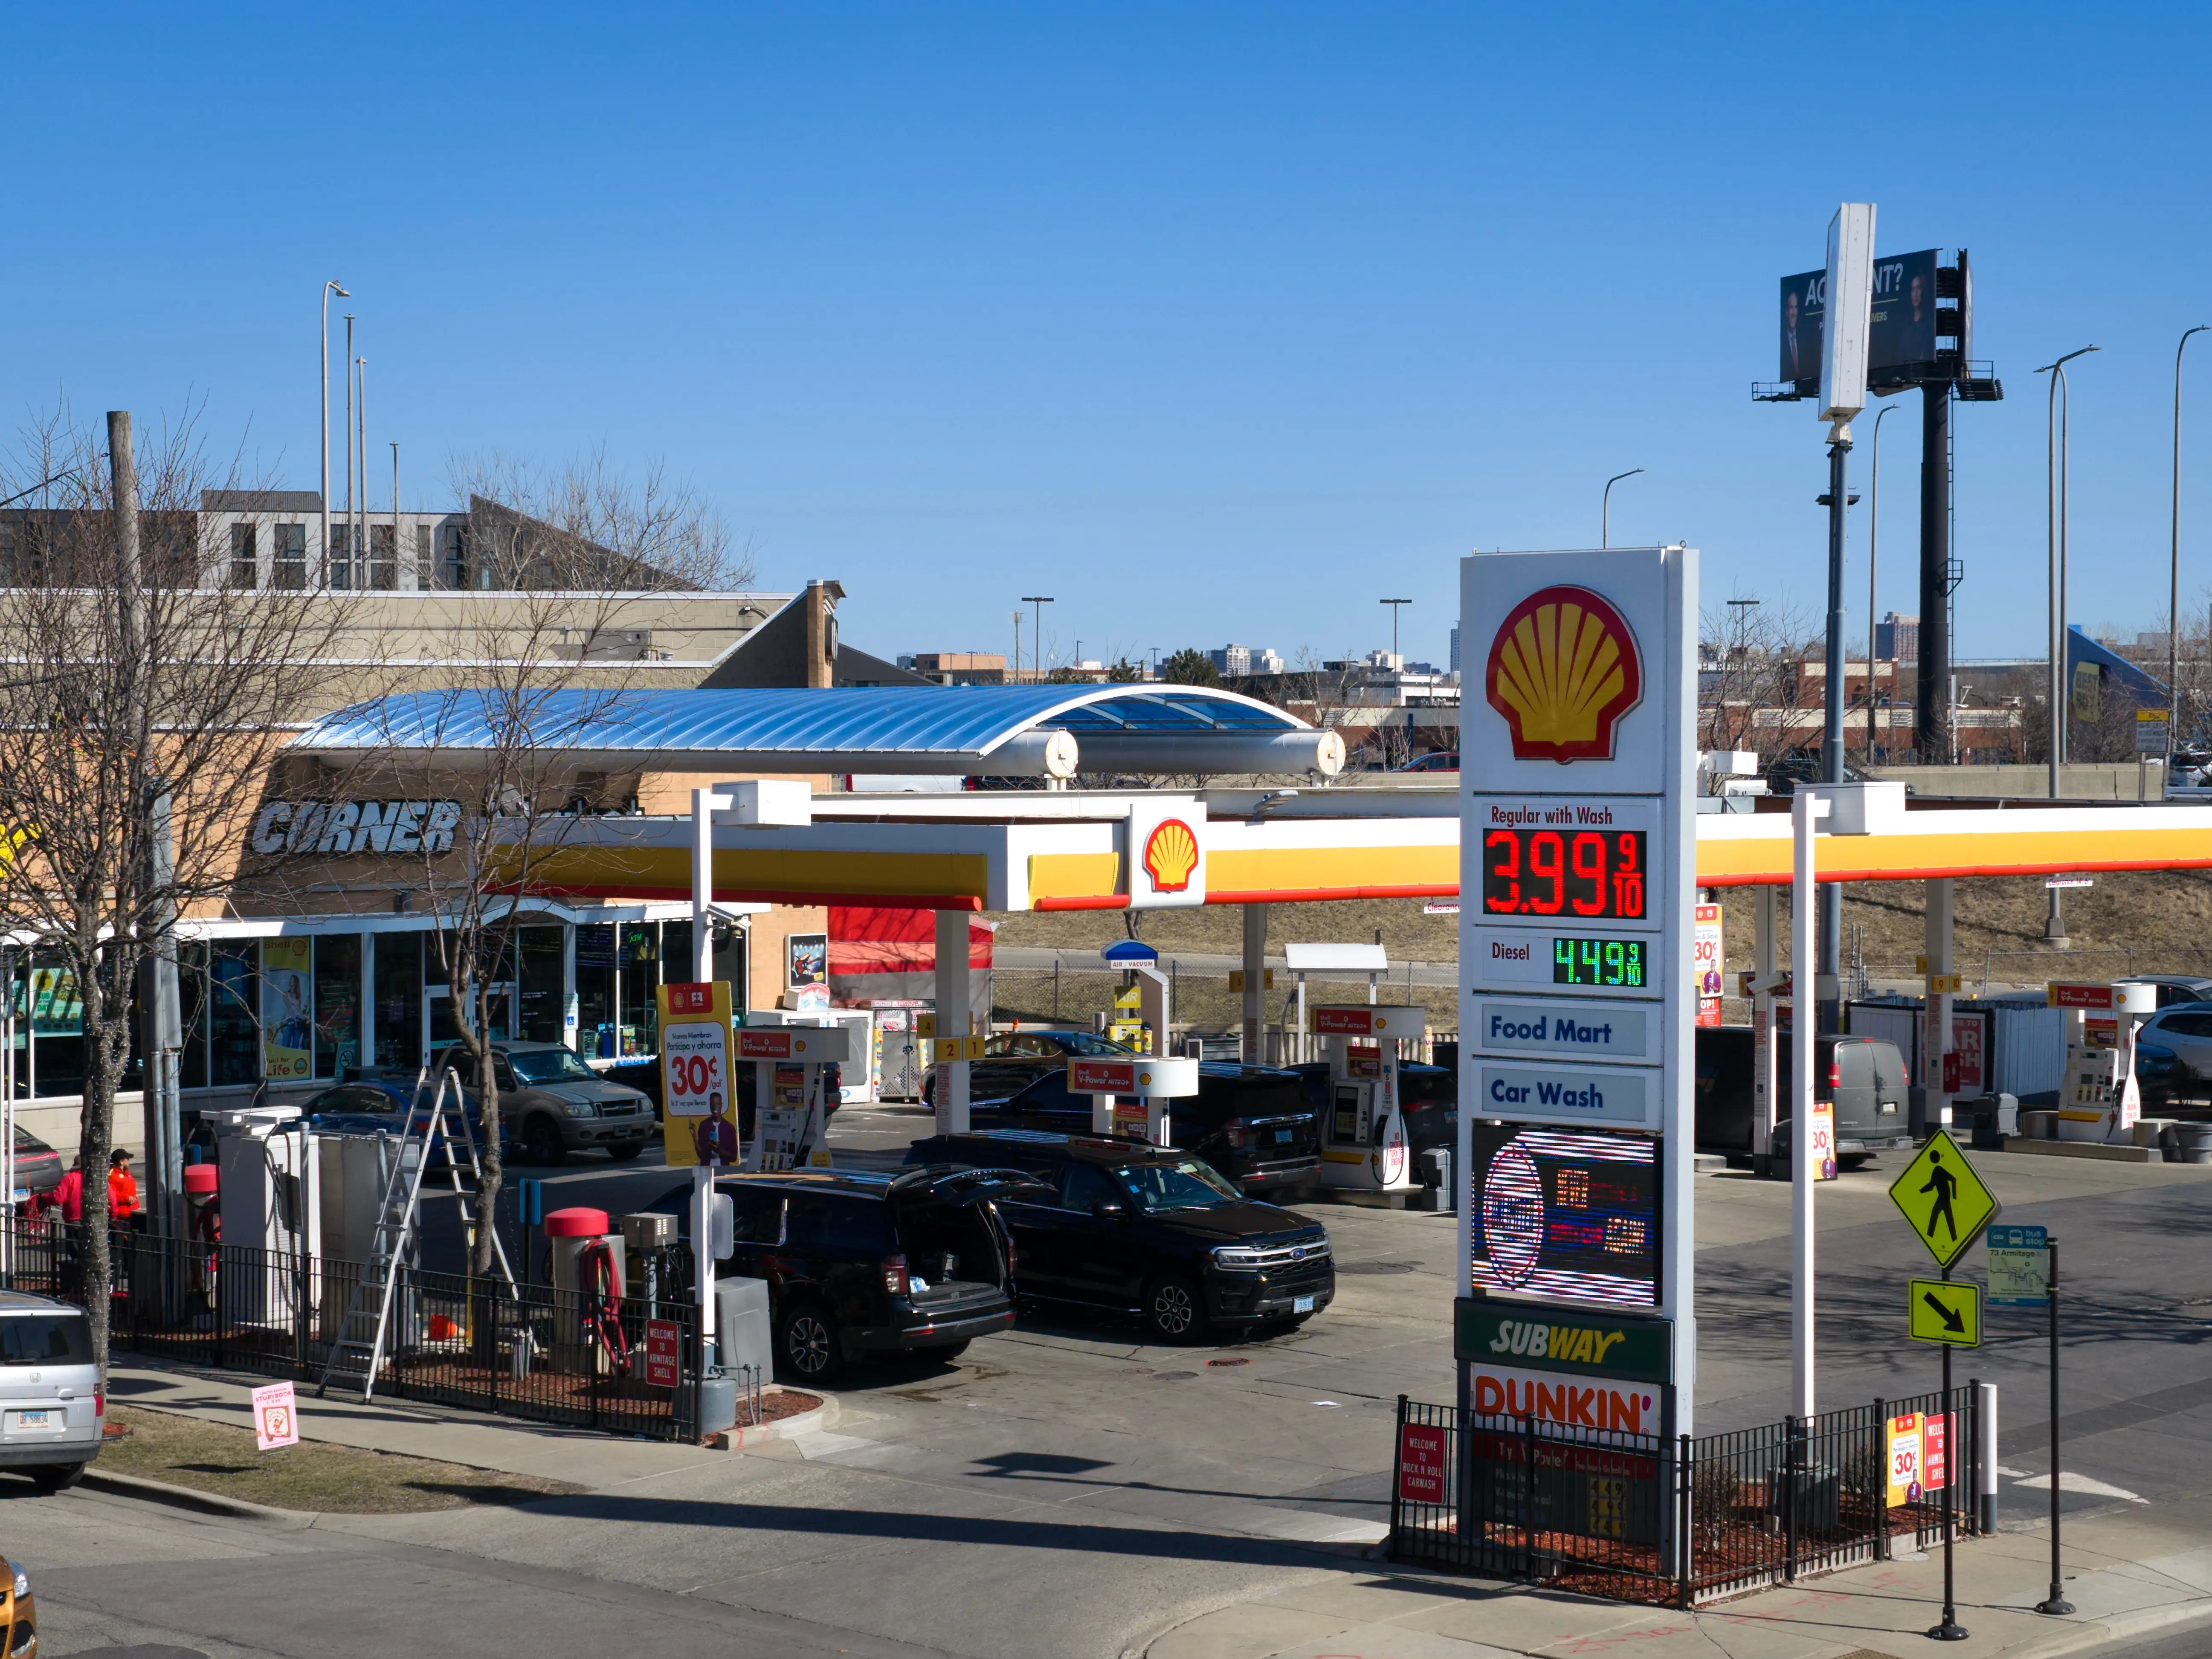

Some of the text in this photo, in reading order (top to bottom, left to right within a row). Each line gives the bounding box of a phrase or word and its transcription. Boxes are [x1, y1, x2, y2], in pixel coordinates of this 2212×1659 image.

[1491, 805, 1612, 828] Regular with Wash
[1428, 902, 1459, 911] Clearanc
[629, 934, 642, 943] ATM
[264, 940, 290, 949] Shell
[1492, 942, 1530, 960] Diesel
[1237, 977, 1241, 986] 5
[1266, 975, 1271, 984] 6
[1939, 980, 1944, 990] 9
[1953, 978, 1959, 988] 10
[1119, 992, 1138, 1002] AIR
[925, 1022, 931, 1030] 4
[1491, 1015, 1612, 1044] Food Mart
[667, 1041, 722, 1053] Participa y ahorra
[946, 1044, 954, 1057] 2
[972, 1042, 977, 1054] 1
[267, 1065, 290, 1076] Life
[1078, 1076, 1107, 1084] V-Power
[1490, 1079, 1603, 1108] Car Wash
[2002, 1250, 2035, 1258] Armitage
[649, 1328, 674, 1340] WELCOME
[659, 1343, 665, 1351] TO
[1489, 1320, 1625, 1363] SUBWAY
[649, 1353, 675, 1366] ARMITAGE
[654, 1367, 670, 1378] SHELL
[255, 1391, 291, 1402] STORYBOOK
[1475, 1375, 1652, 1435] DUNKIN'
[1409, 1438, 1438, 1451] WELCOME
[1419, 1453, 1426, 1462] TO
[1403, 1462, 1442, 1477] ROCK N ROLL
[1407, 1476, 1436, 1490] CARWASH
